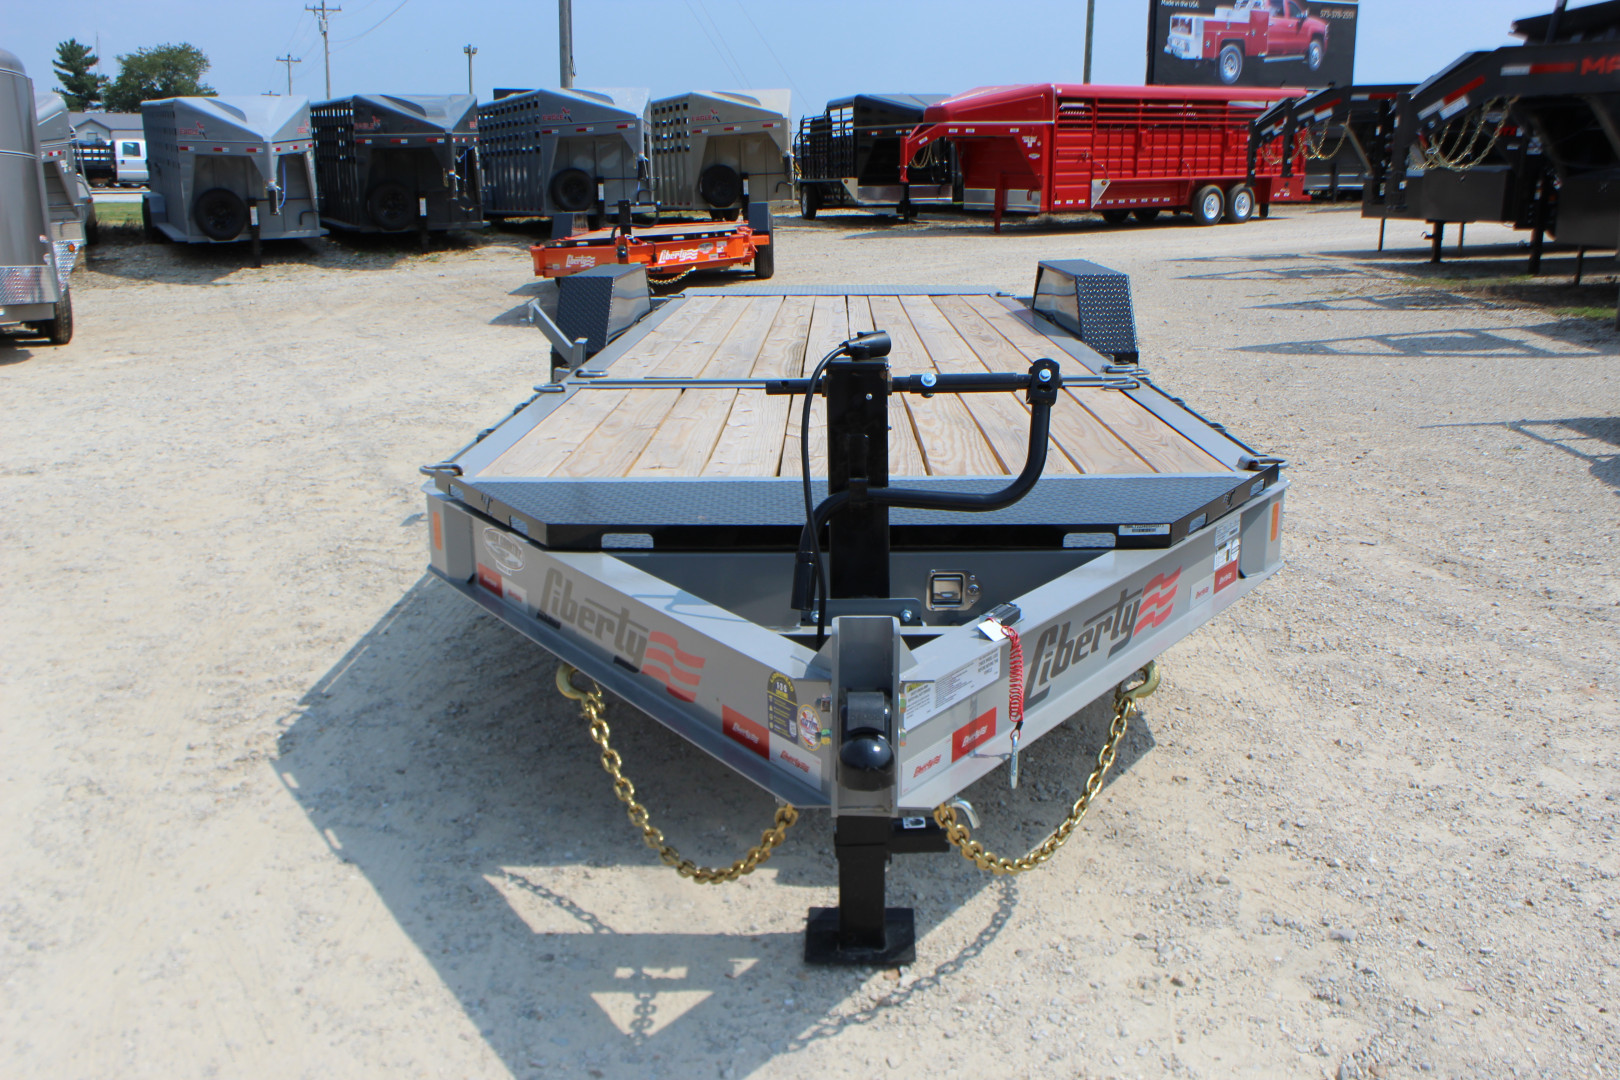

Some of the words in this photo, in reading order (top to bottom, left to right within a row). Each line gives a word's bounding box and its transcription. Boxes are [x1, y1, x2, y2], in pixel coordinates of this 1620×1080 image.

[565, 254, 589, 267] Liberty
[658, 248, 688, 264] Liberty
[536, 567, 649, 673] Liberty
[1022, 588, 1143, 712] Liberty
